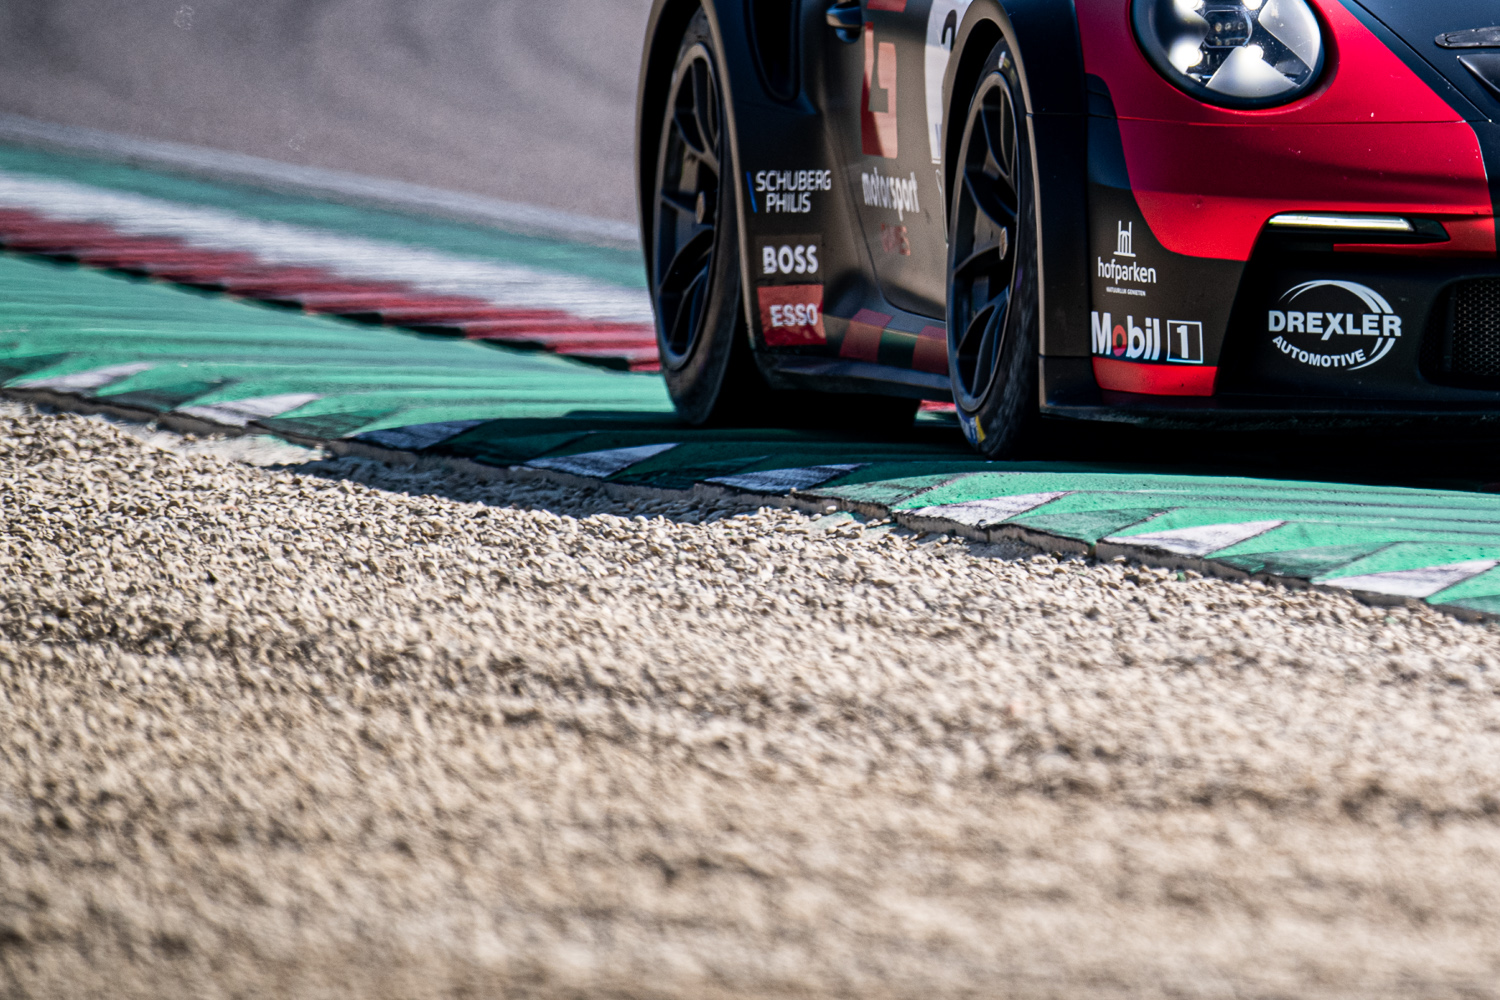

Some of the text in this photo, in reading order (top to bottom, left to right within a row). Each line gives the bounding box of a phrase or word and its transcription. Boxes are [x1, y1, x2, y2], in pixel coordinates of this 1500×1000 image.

[755, 169, 832, 192] SCHUBERG
[861, 167, 920, 222] motorsport
[765, 191, 812, 214] PHILIS
[762, 244, 819, 275] BOSS
[1097, 256, 1157, 285] hofparken
[769, 302, 819, 328] ESSO
[1267, 310, 1402, 341] DREXLER
[1090, 310, 1189, 361] Mobil 1
[1271, 335, 1367, 368] AUTOMOTIVE
